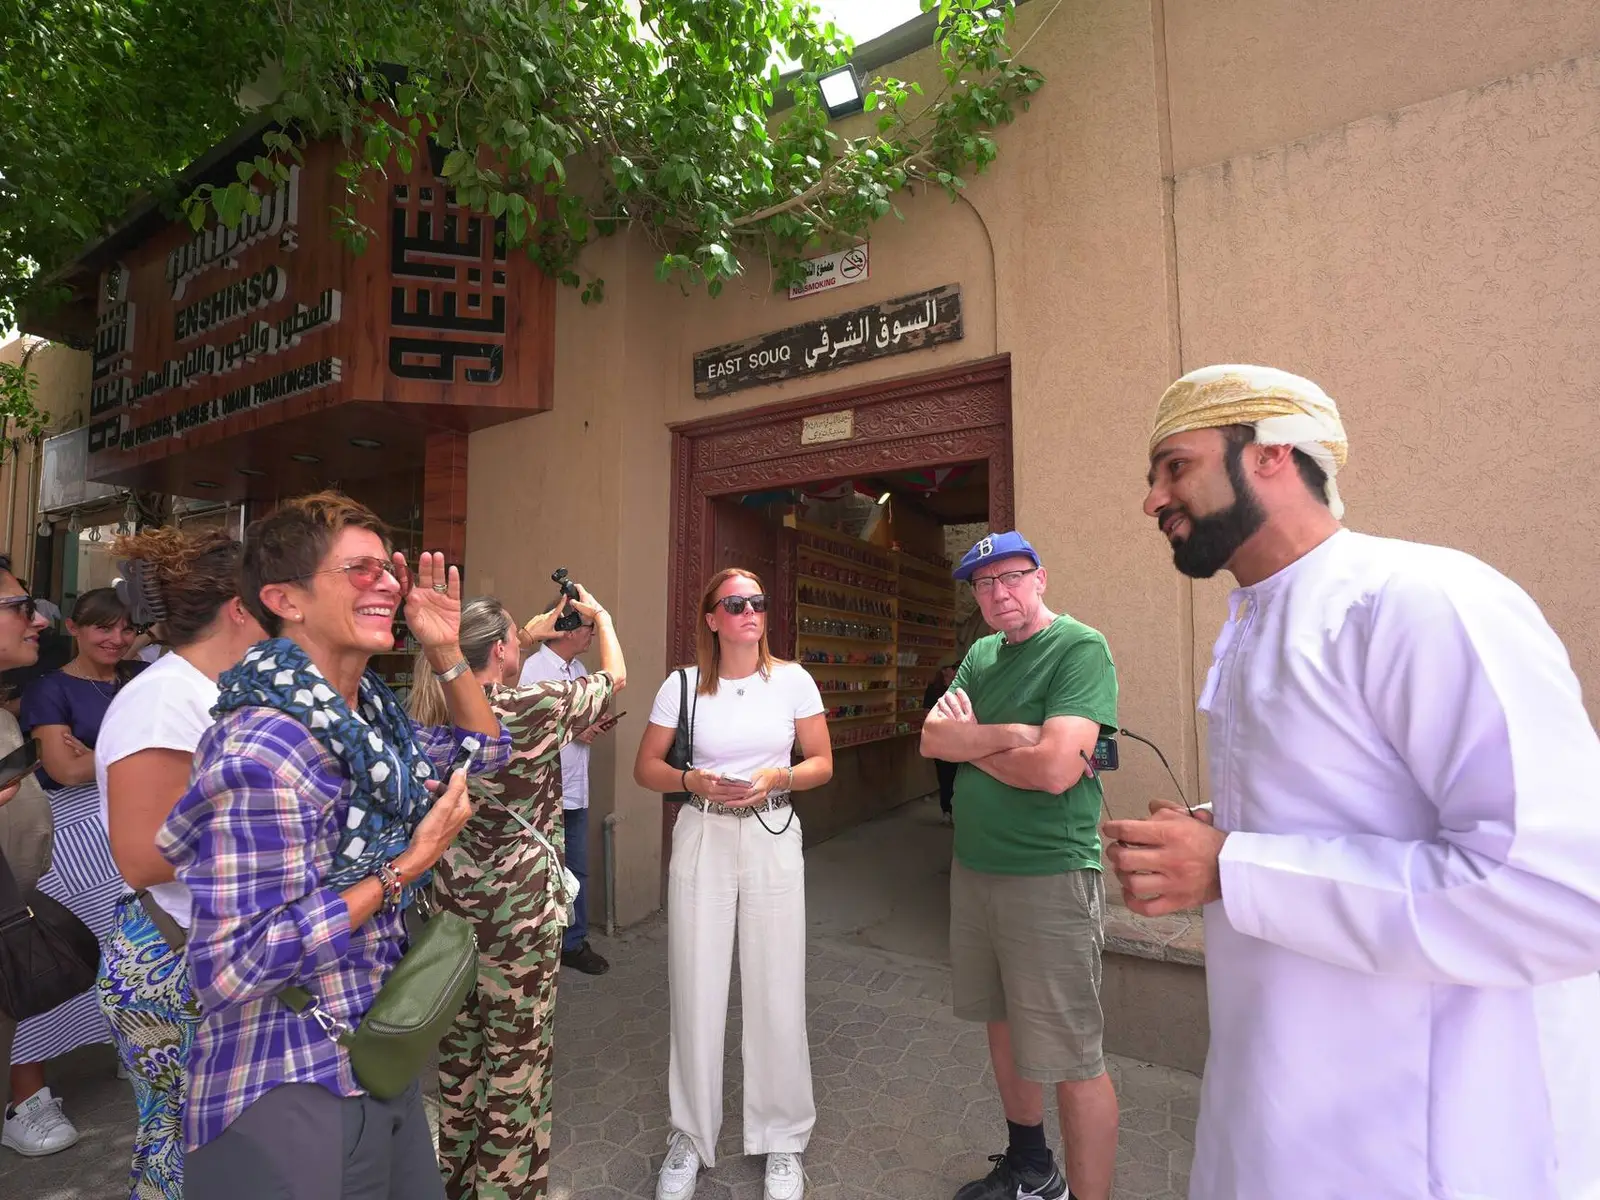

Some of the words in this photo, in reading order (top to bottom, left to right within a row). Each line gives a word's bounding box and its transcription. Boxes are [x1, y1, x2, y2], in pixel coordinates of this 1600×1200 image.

[175, 265, 286, 343] ENSHINSO
[804, 277, 836, 293] SMOKING
[804, 315, 870, 368] الشرقي
[875, 298, 937, 349] السوق
[707, 357, 742, 378] EAST
[748, 345, 791, 369] SOUQ
[176, 401, 211, 431] INCENSE
[222, 385, 253, 415] OMANI
[254, 356, 341, 405] FRANKINCENSE
[976, 537, 994, 559] B
